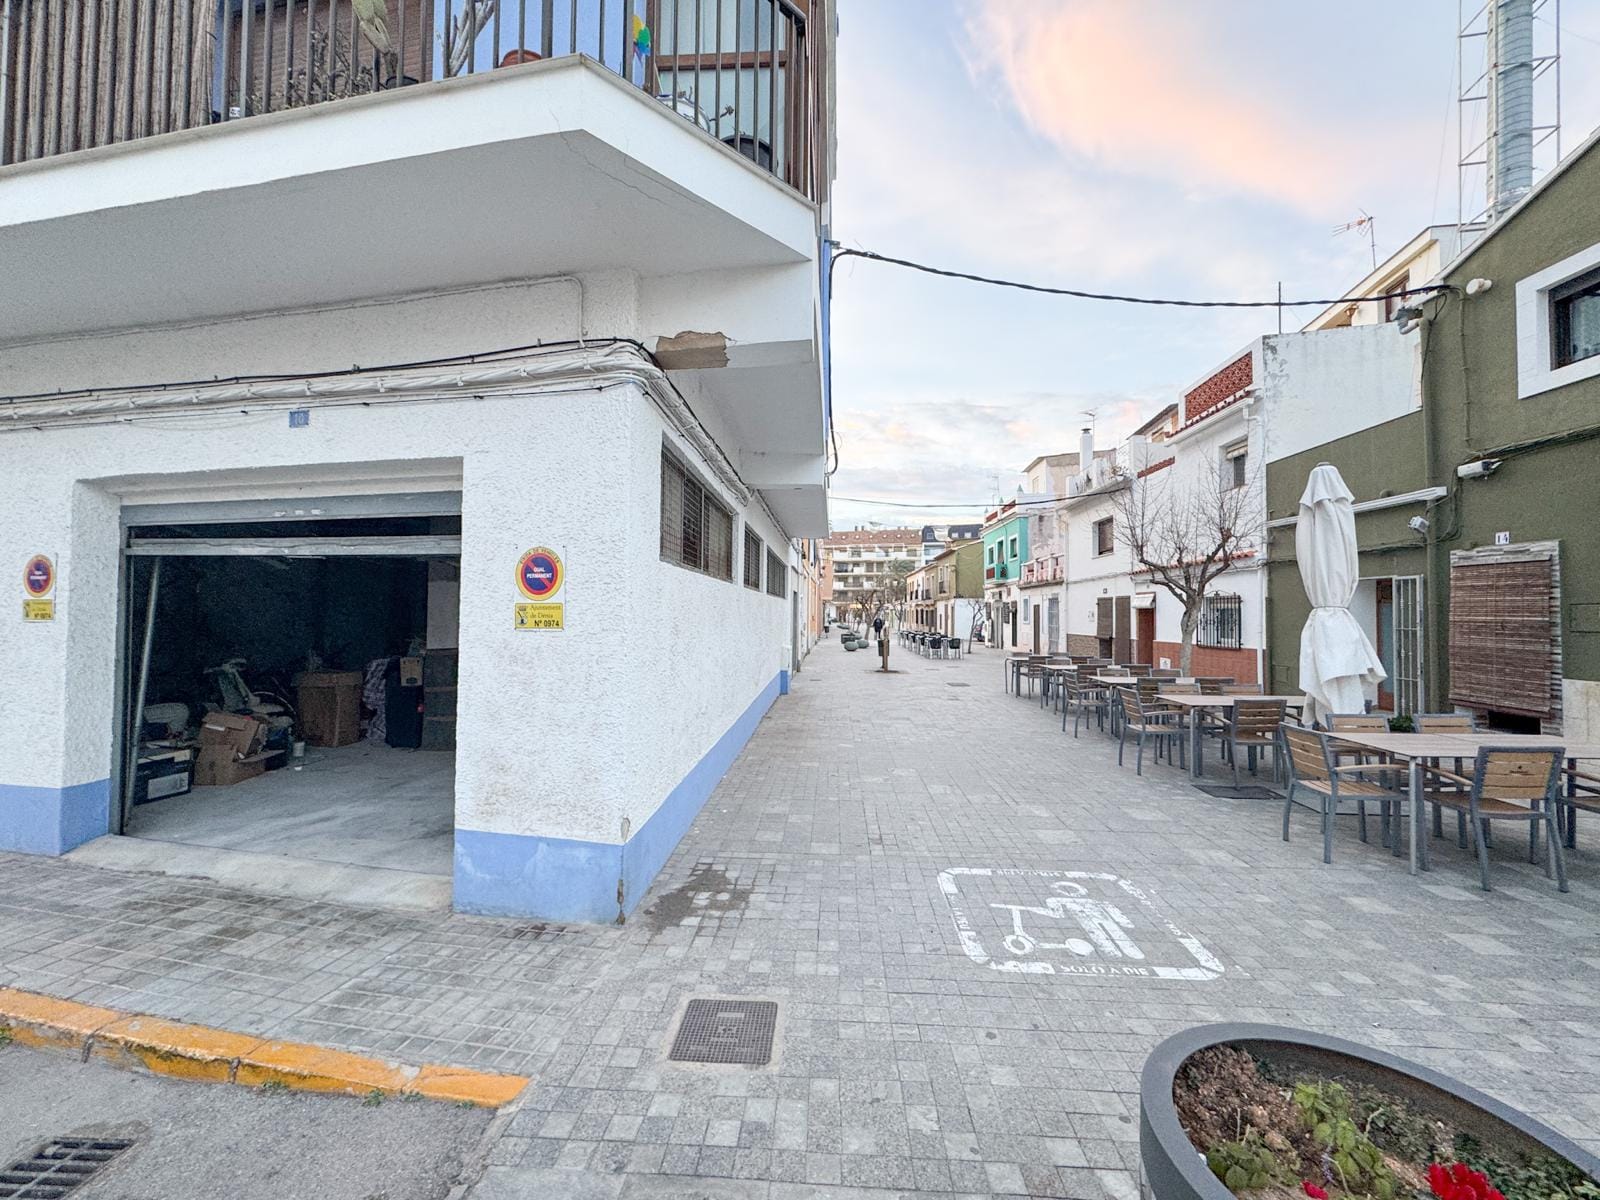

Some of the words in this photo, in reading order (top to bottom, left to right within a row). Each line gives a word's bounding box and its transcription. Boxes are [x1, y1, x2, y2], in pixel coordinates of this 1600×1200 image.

[1497, 533, 1508, 544] 14
[543, 619, 560, 627] 0974
[1060, 965, 1105, 974] SOLO
